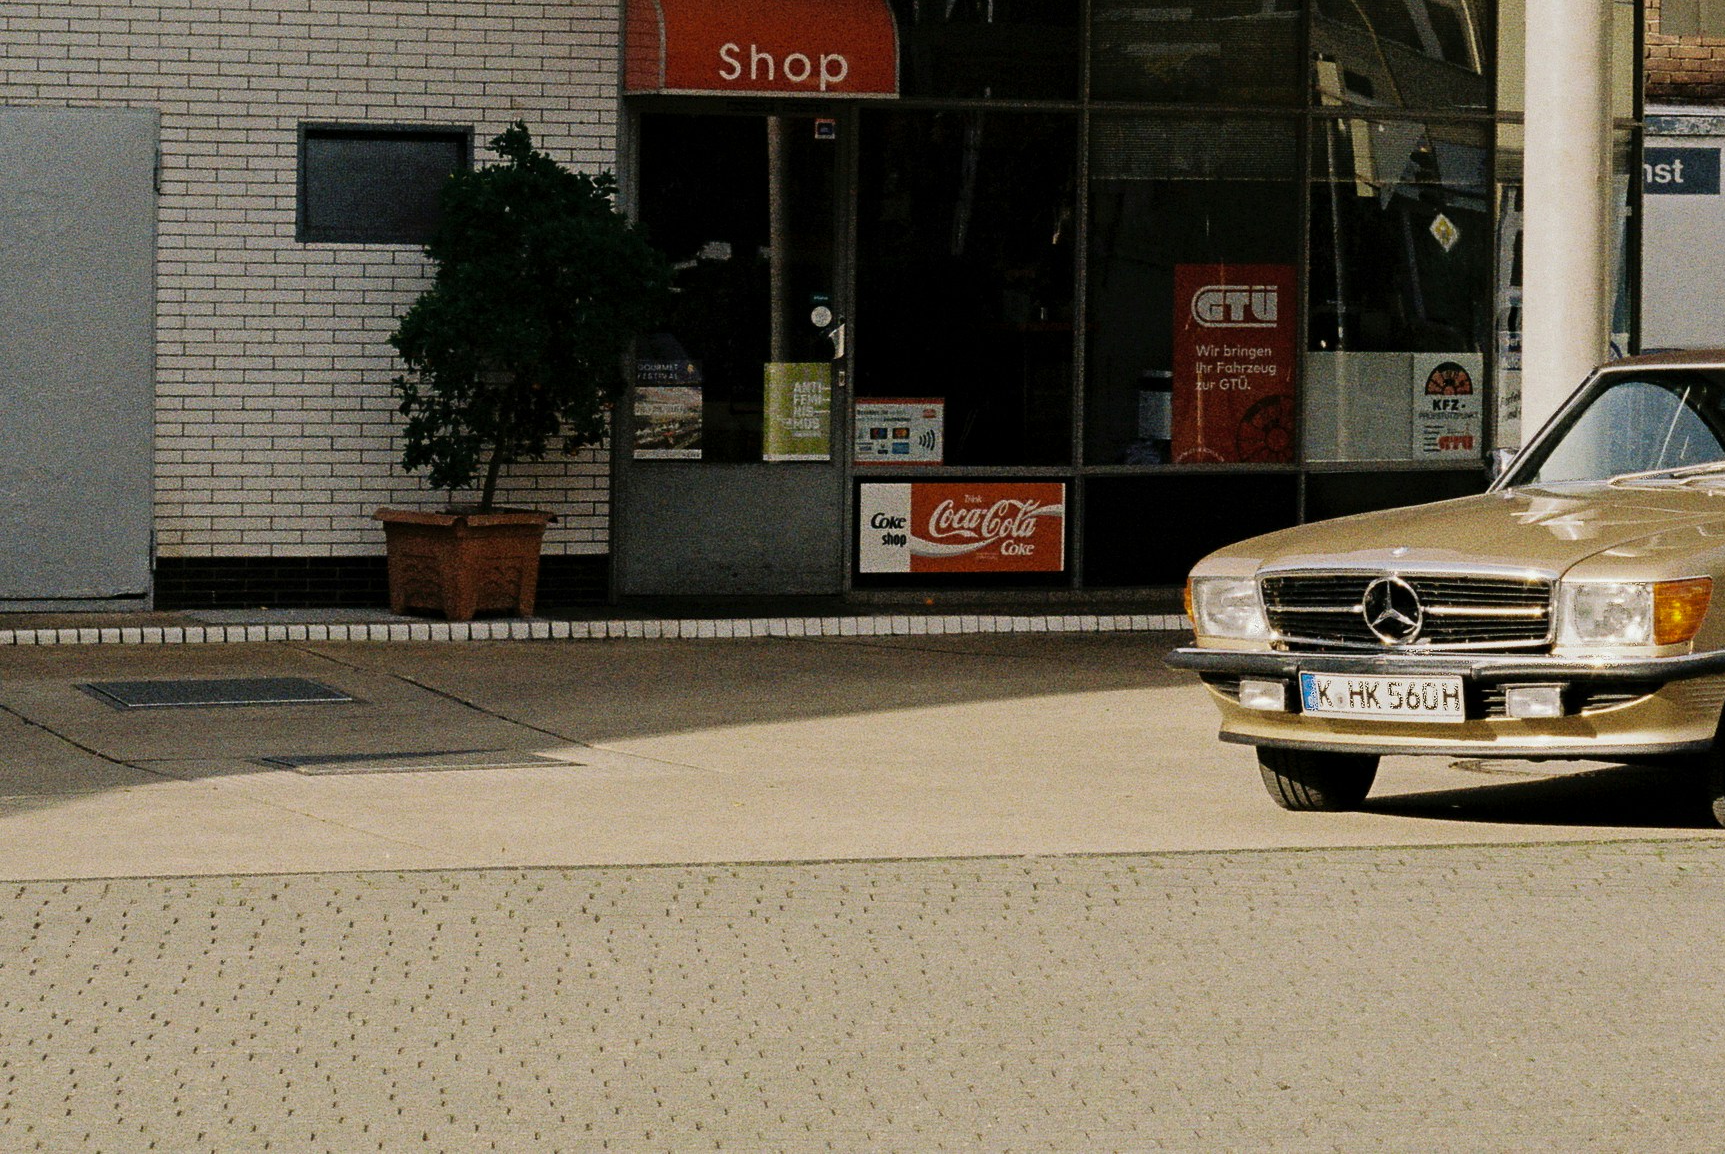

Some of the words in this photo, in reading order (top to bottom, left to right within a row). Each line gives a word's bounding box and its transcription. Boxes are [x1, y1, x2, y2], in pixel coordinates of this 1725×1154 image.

[719, 43, 848, 91] Shop
[1195, 346, 1219, 357] Wir
[1223, 345, 1272, 360] bringen
[1195, 362, 1213, 374] Ihr
[1216, 362, 1277, 376] Fahrzeug
[1195, 381, 1215, 391] zur
[1218, 376, 1251, 391] GTÜ.
[964, 494, 983, 503] Trink
[871, 512, 907, 530] Coke
[929, 499, 1041, 538] Coca-Cola
[882, 532, 907, 548] shop
[1000, 539, 1035, 556] Coke
[1317, 679, 1334, 708] K
[1348, 680, 1382, 709] HK
[1387, 681, 1460, 712] 560H
